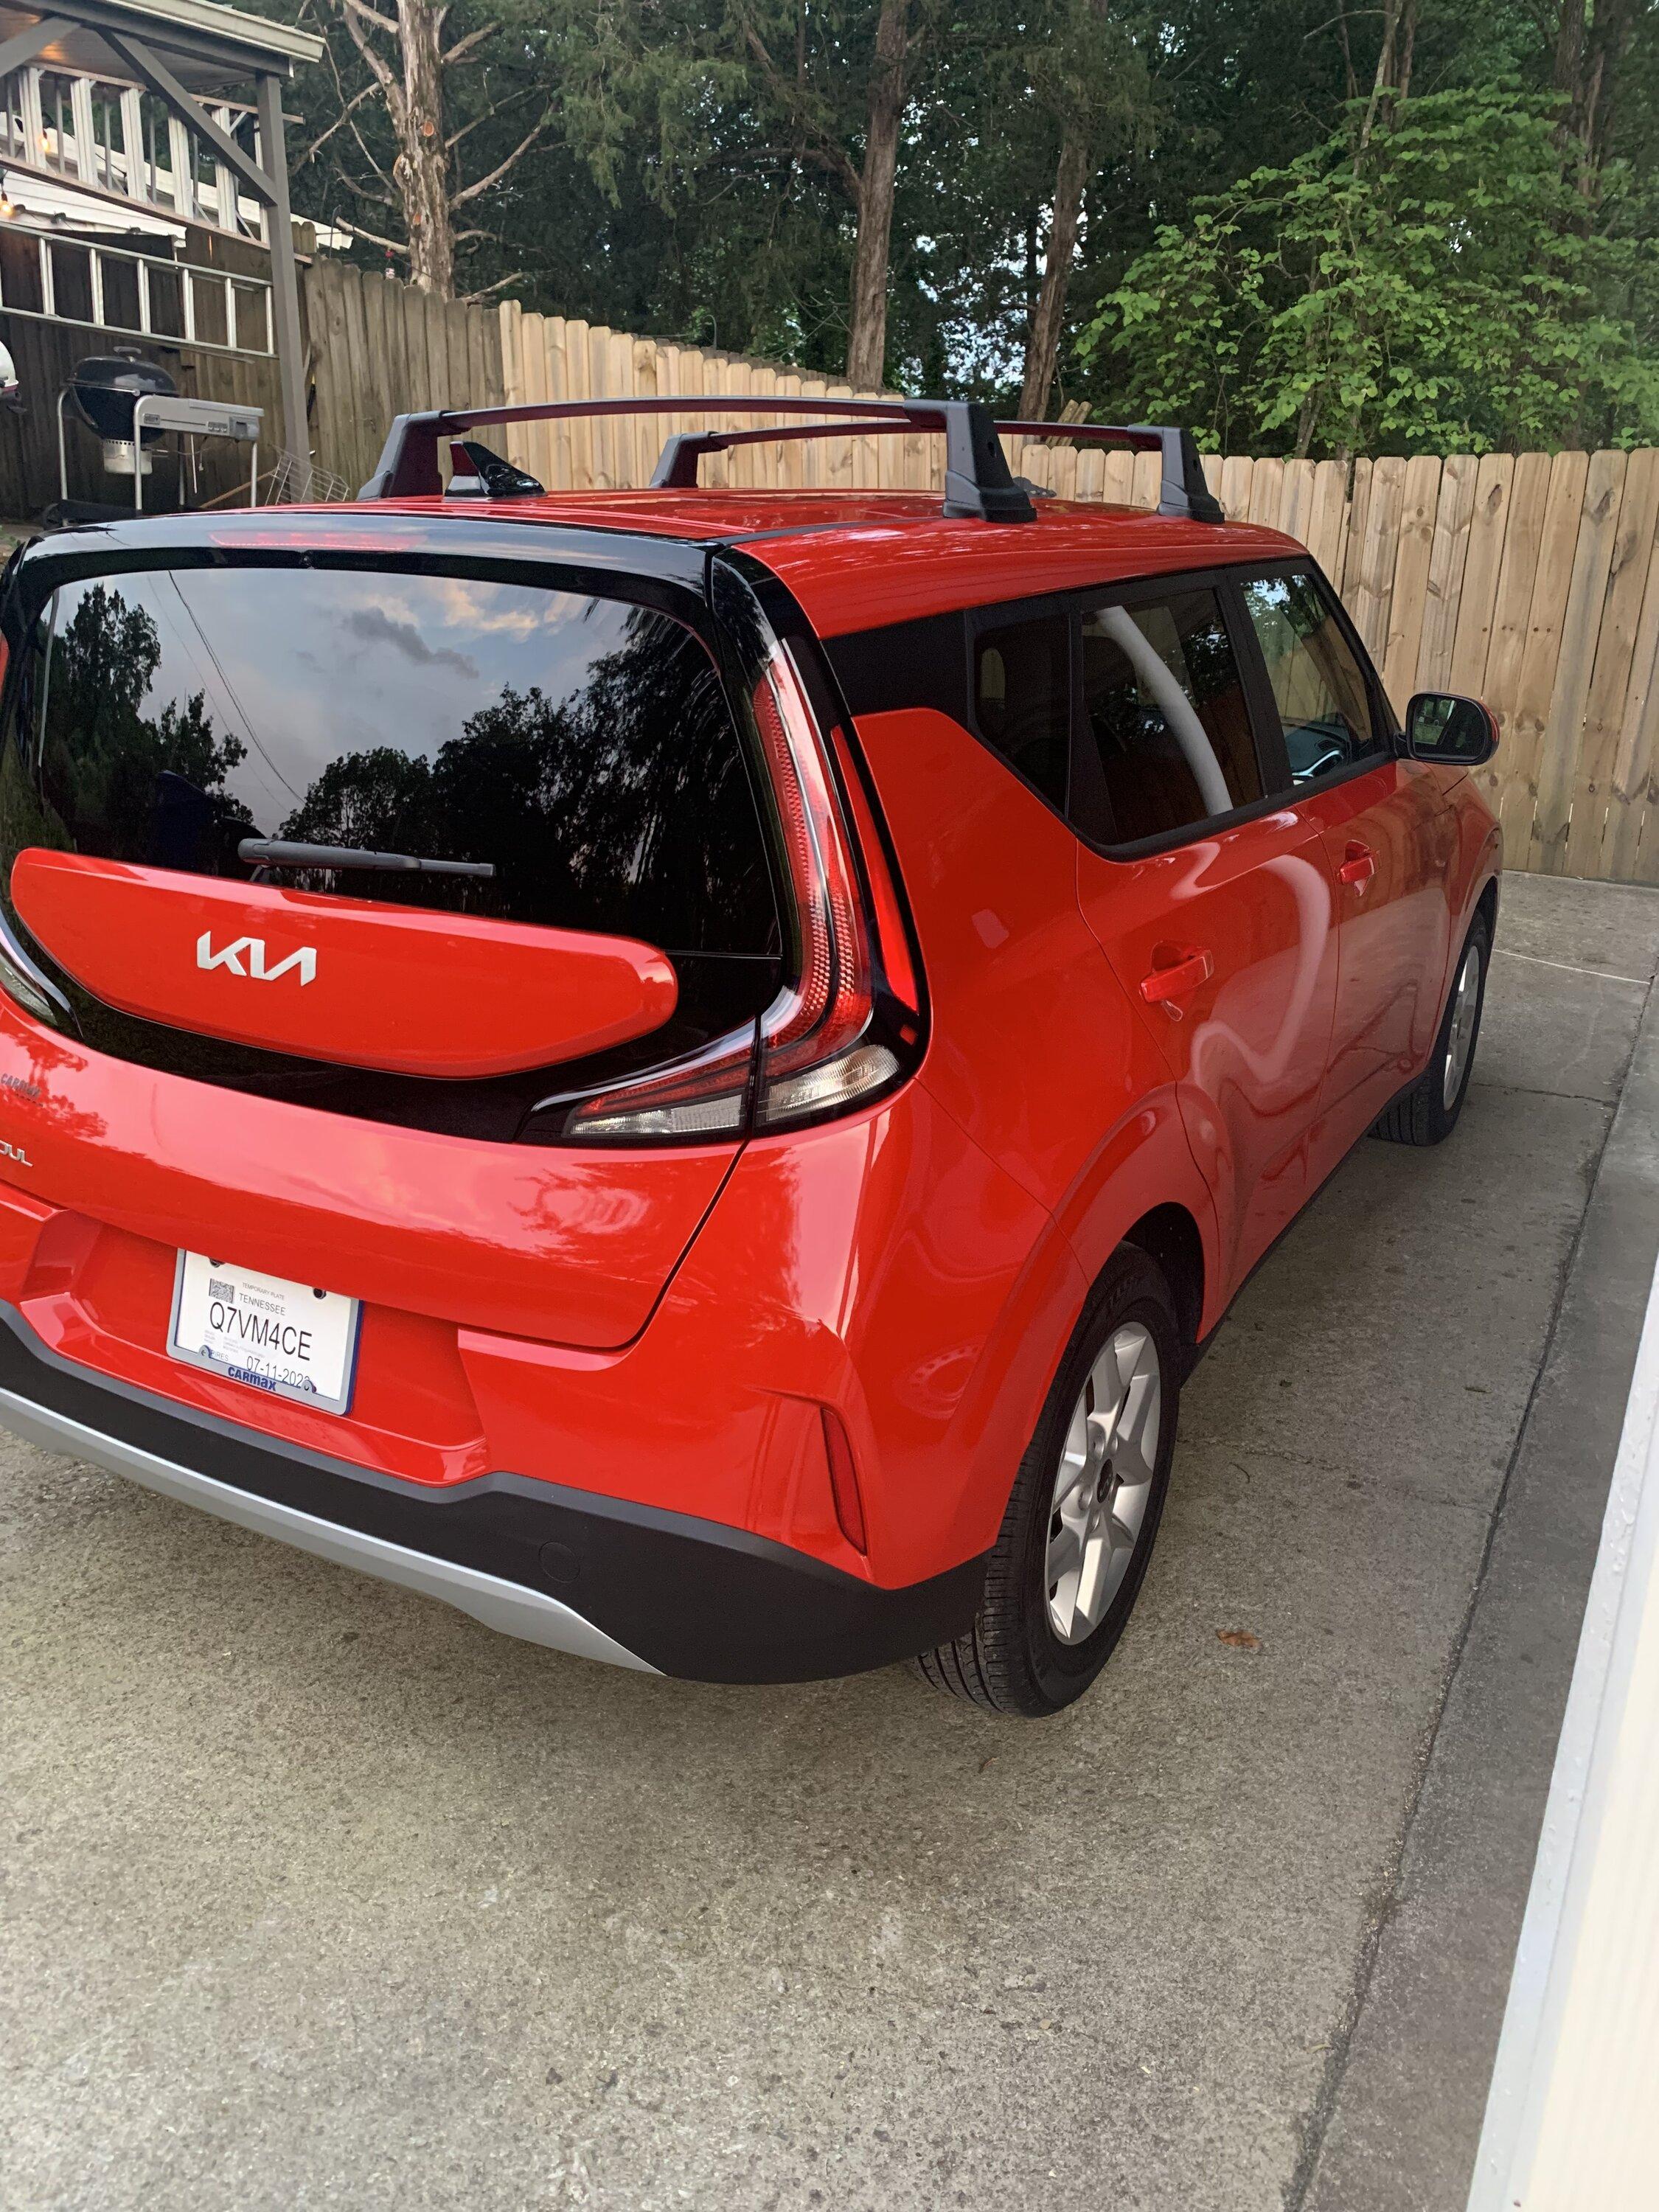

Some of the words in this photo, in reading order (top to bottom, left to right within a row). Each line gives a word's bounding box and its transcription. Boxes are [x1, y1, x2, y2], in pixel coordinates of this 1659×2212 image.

[197, 931, 317, 987] KIA
[0, 1140, 32, 1167] OUL
[239, 1293, 286, 1316] TENNESSEE
[242, 1282, 270, 1295] TEMPORARY
[270, 1291, 285, 1301] PLATE
[209, 1301, 313, 1361] Q7VM4CE
[246, 1355, 310, 1388] 07-11-202
